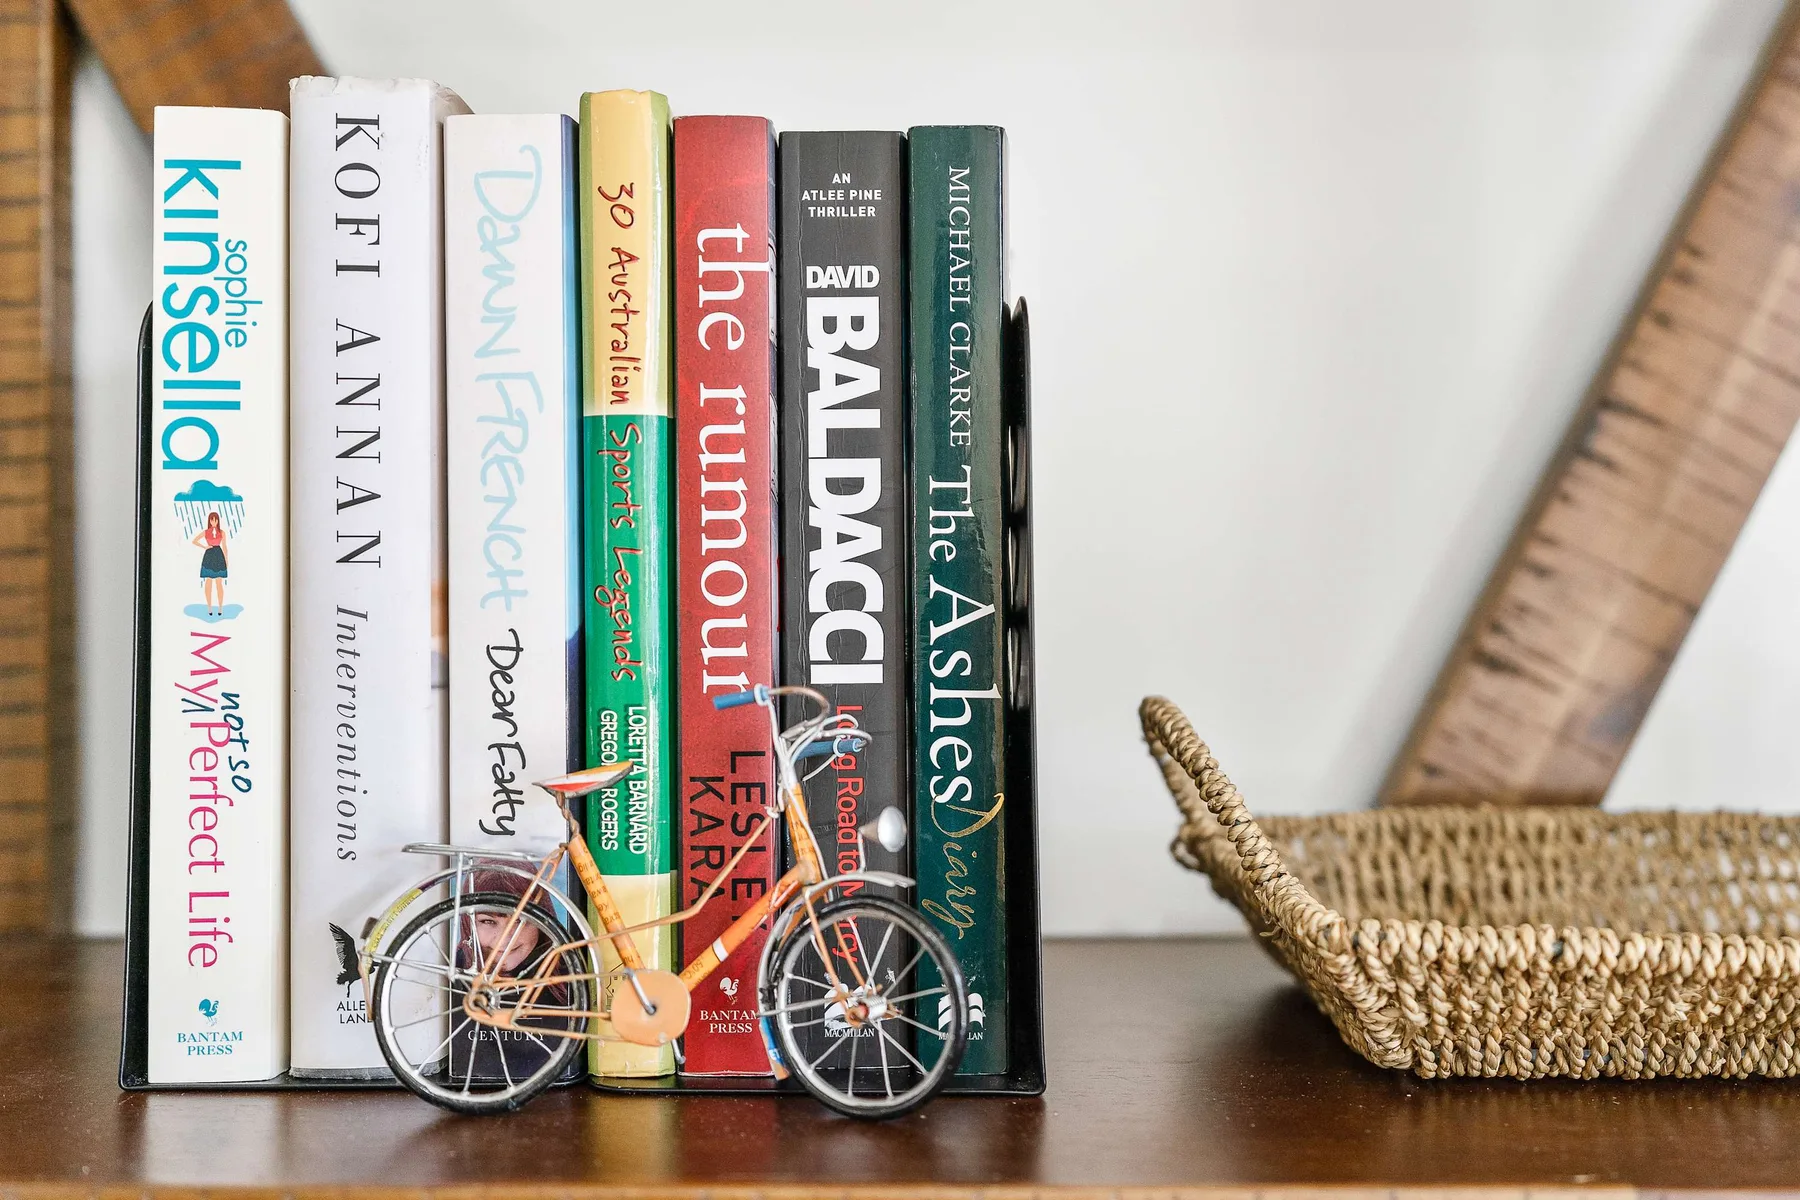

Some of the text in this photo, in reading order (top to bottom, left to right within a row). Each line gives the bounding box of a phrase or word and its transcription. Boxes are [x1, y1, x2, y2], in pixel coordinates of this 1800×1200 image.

[802, 189, 882, 201] ATLEE PINE
[808, 205, 876, 218] THRILLER
[832, 172, 851, 185] AN
[161, 159, 242, 470] kinsella
[213, 238, 263, 349] sophie
[806, 265, 880, 289] DAVID
[334, 113, 382, 862] KOFI ANNAN Interventions
[594, 182, 644, 682] 30 Australian Sports Legends
[697, 222, 770, 694] the rumour
[806, 295, 884, 684] BALDACCI
[921, 165, 1005, 940] MICHAEL CLARKE The Ashes Diary
[220, 692, 252, 793] not so
[478, 628, 527, 836] Dear Fatty
[600, 709, 618, 851] GREGO ROGERS
[628, 706, 649, 855] LORETTA BARNARD
[174, 631, 234, 968] My Perfect Life
[689, 776, 725, 907] KARA
[730, 750, 768, 931] LESLE
[836, 777, 865, 845] Road
[837, 849, 861, 876] to
[177, 1031, 243, 1044] BANTAM
[187, 1045, 233, 1057] PRESS
[336, 1001, 366, 1011] ALLE
[709, 1022, 753, 1034] PRESS
[824, 1028, 875, 1038] MACMILLAN
